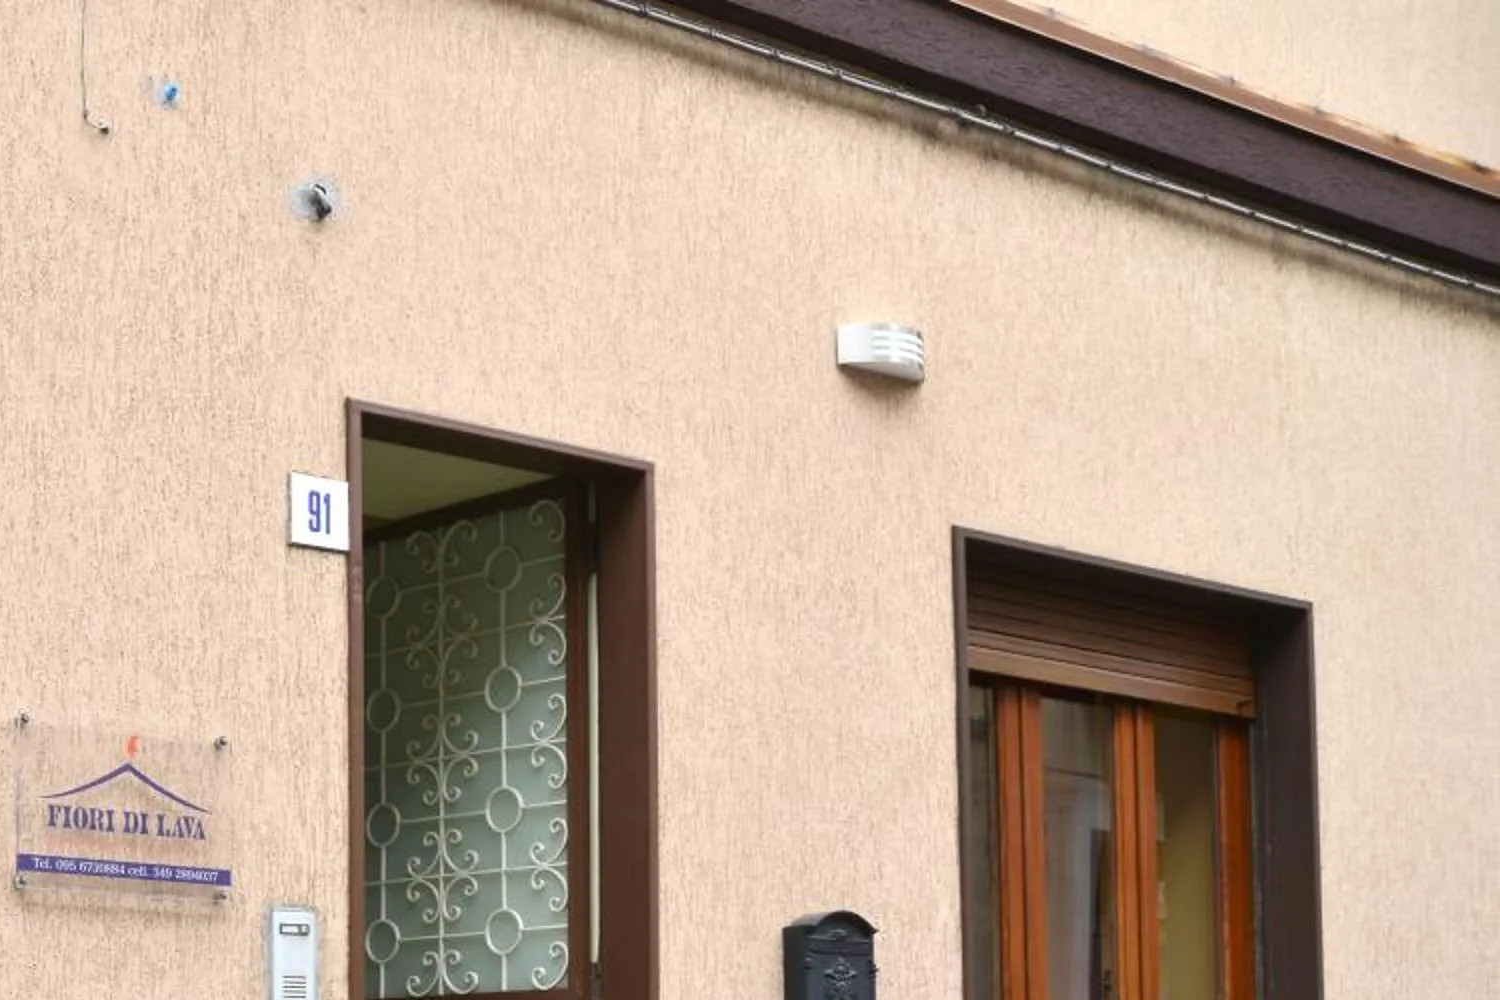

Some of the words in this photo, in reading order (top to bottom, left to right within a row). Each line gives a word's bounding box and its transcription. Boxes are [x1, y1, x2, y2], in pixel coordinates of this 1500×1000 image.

[308, 489, 331, 535] 91
[47, 803, 115, 833] FIORI
[123, 810, 149, 836] DI
[156, 813, 206, 841] LAVA
[32, 857, 53, 870] Tel.
